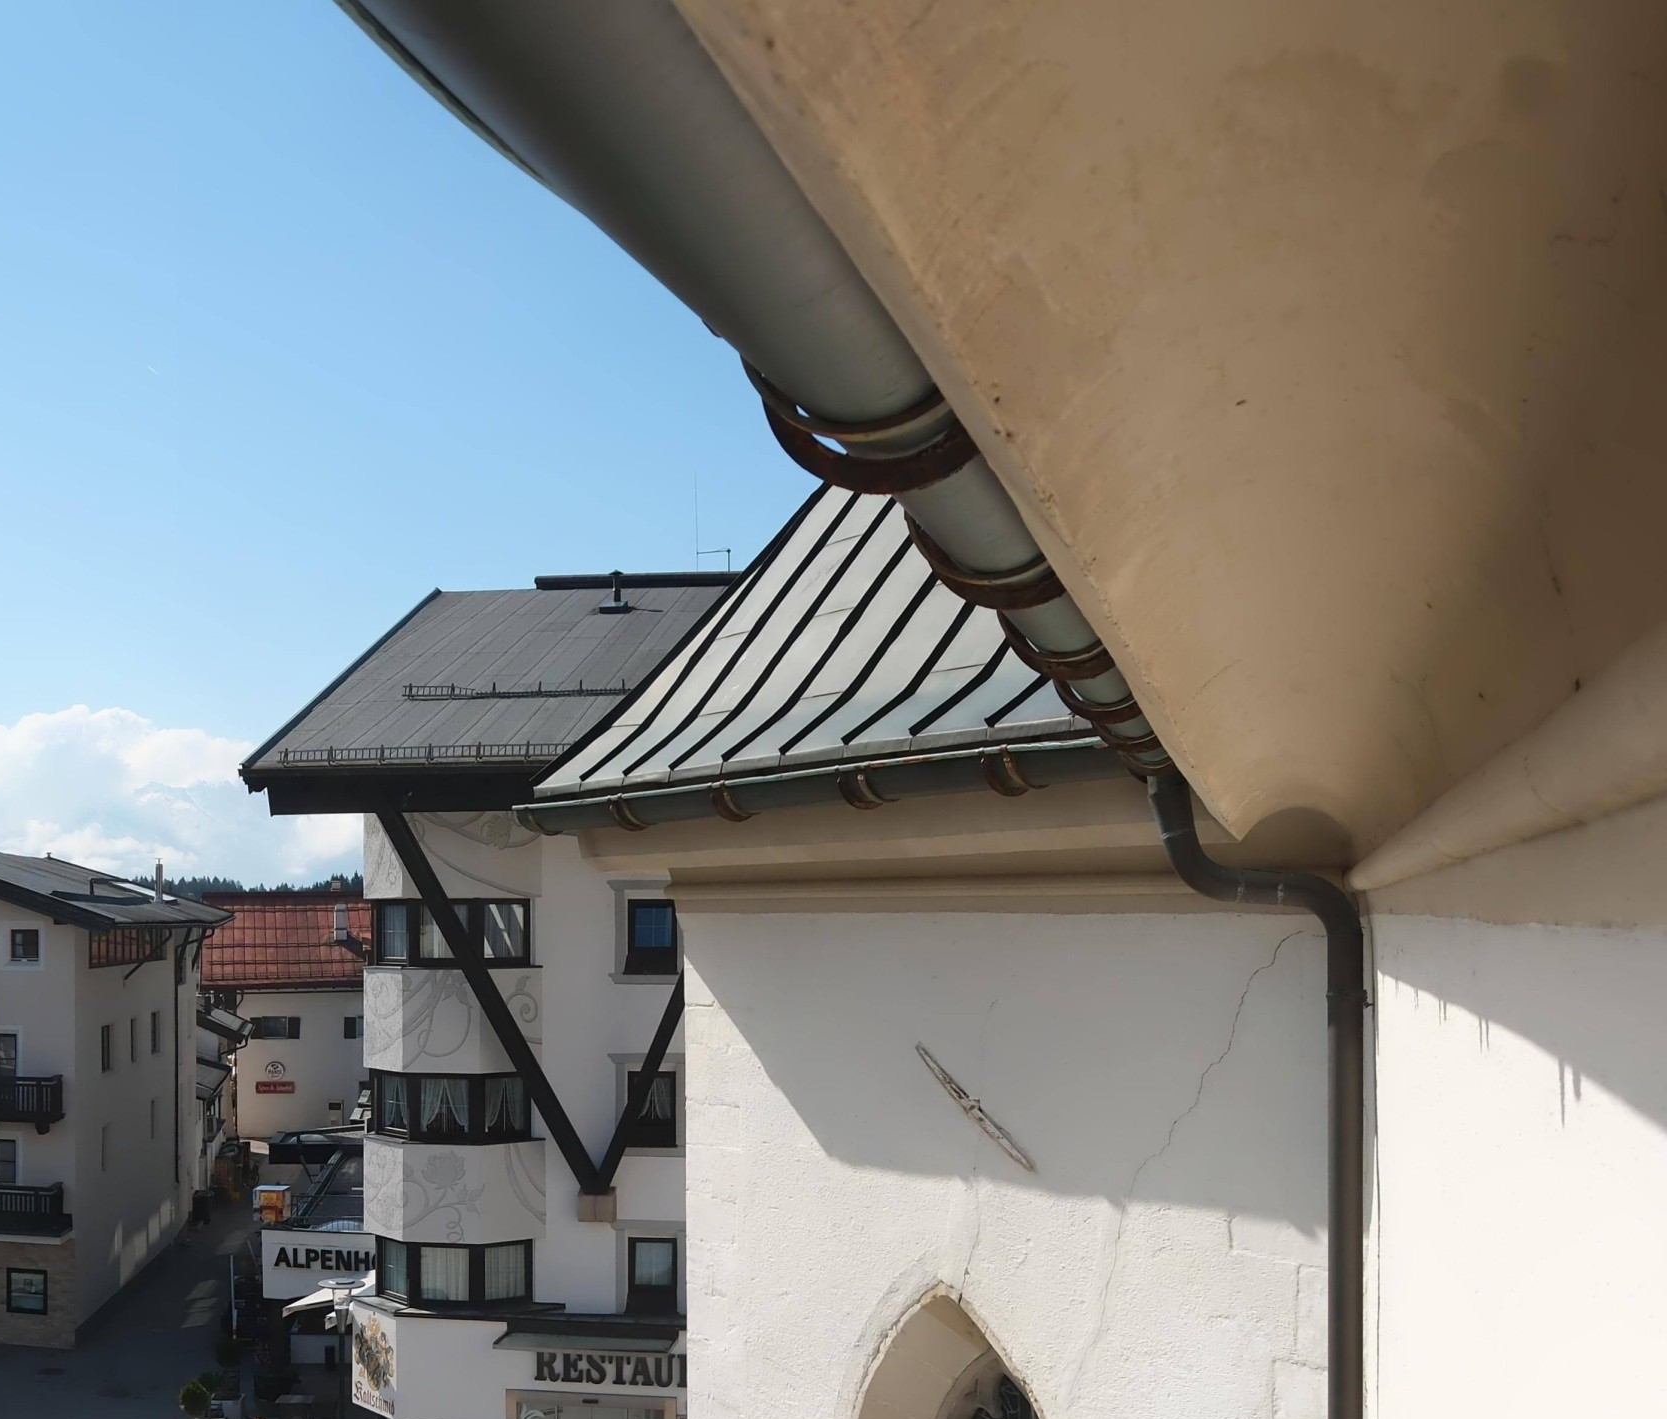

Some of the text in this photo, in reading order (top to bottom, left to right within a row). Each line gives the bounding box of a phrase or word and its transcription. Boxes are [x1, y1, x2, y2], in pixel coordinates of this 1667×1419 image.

[273, 1246, 376, 1272] ALPENH
[534, 1352, 688, 1388] RESTAU
[353, 1380, 396, 1416] Kaltschmid
